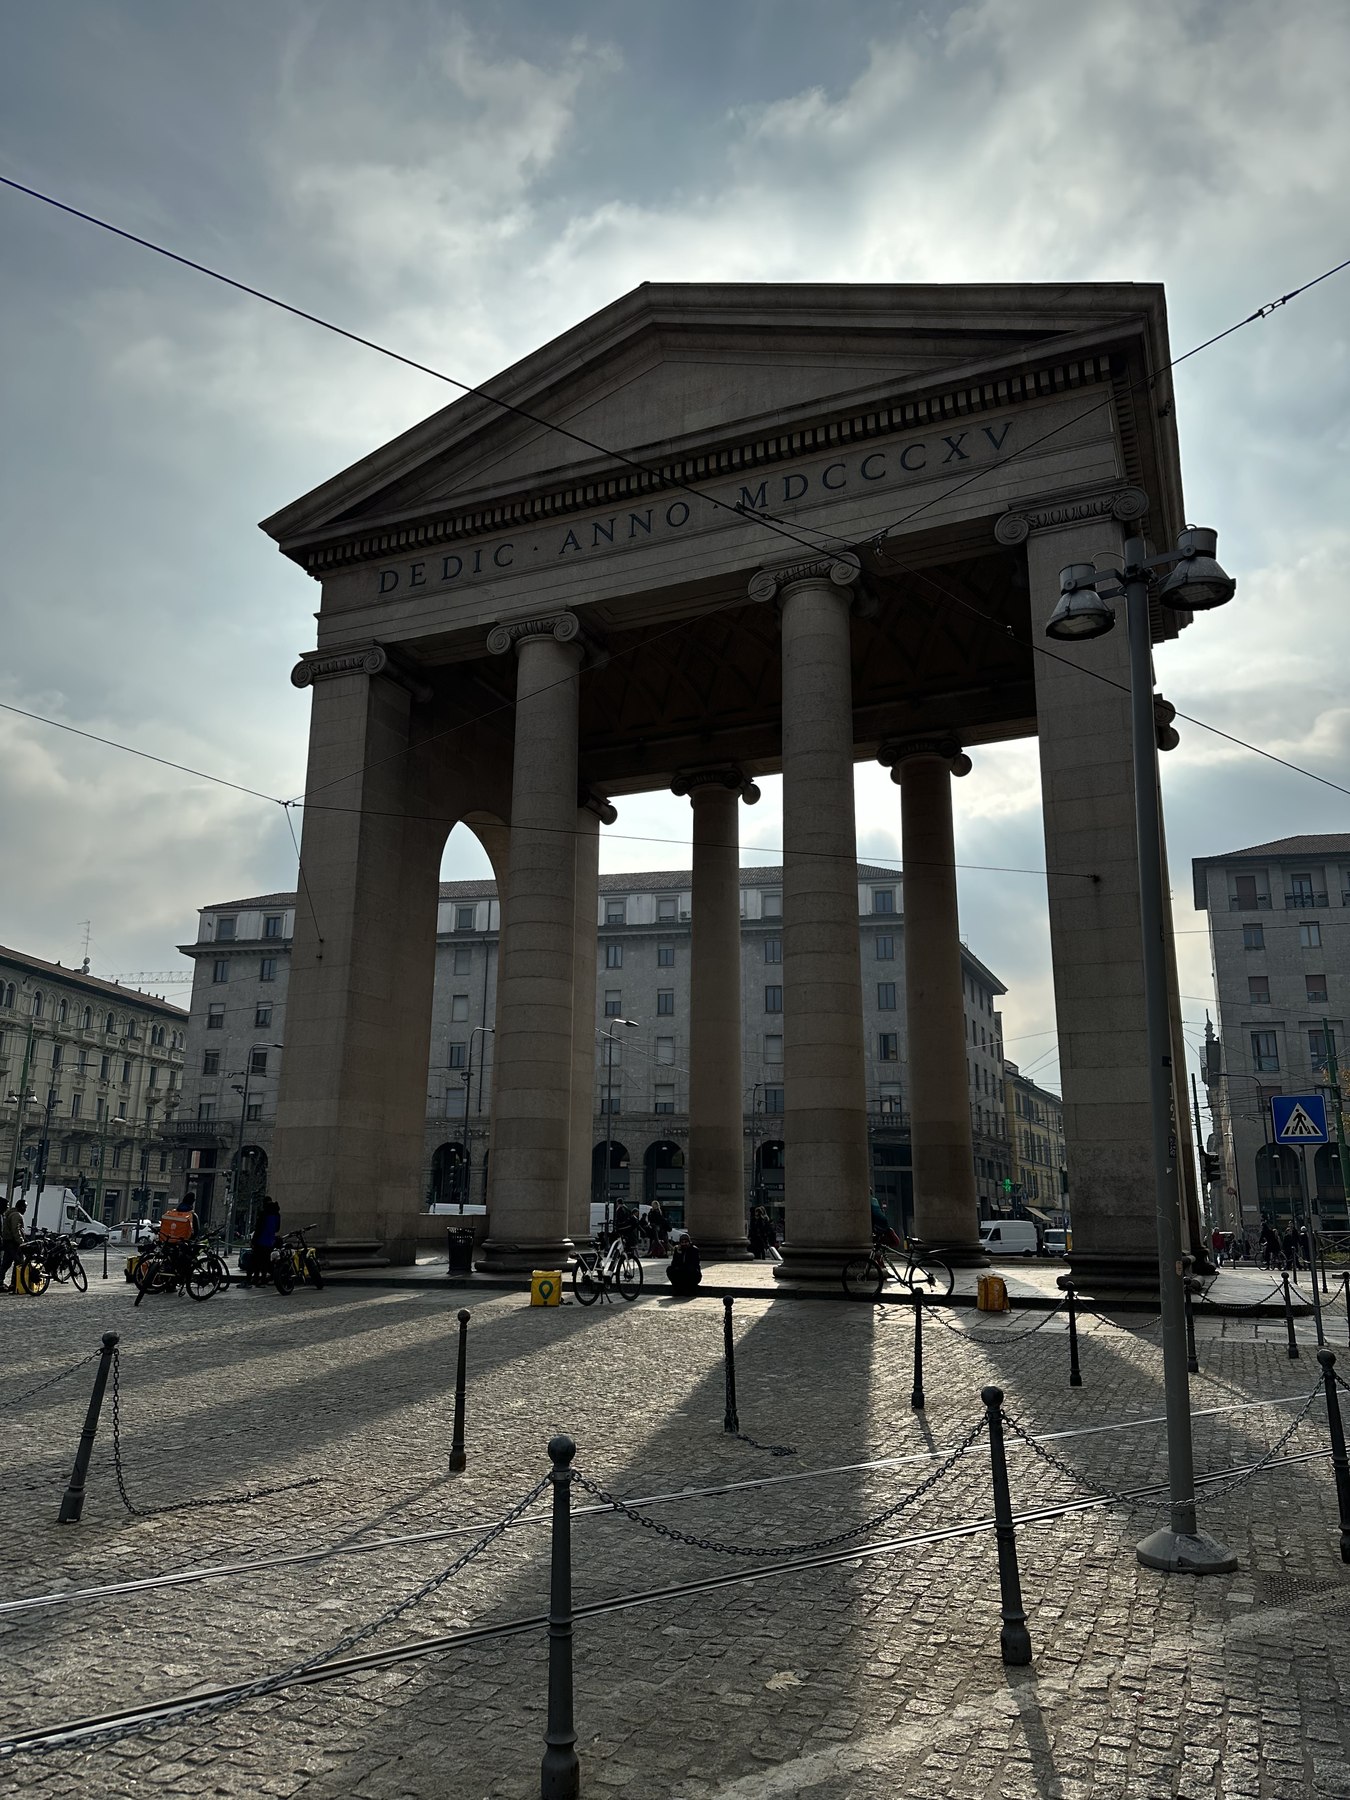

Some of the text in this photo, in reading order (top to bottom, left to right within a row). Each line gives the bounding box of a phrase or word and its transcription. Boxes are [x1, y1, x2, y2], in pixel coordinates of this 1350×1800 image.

[379, 543, 514, 594] DEDIC
[559, 501, 690, 554] ANNO
[738, 422, 1013, 509] MDCCCXV
